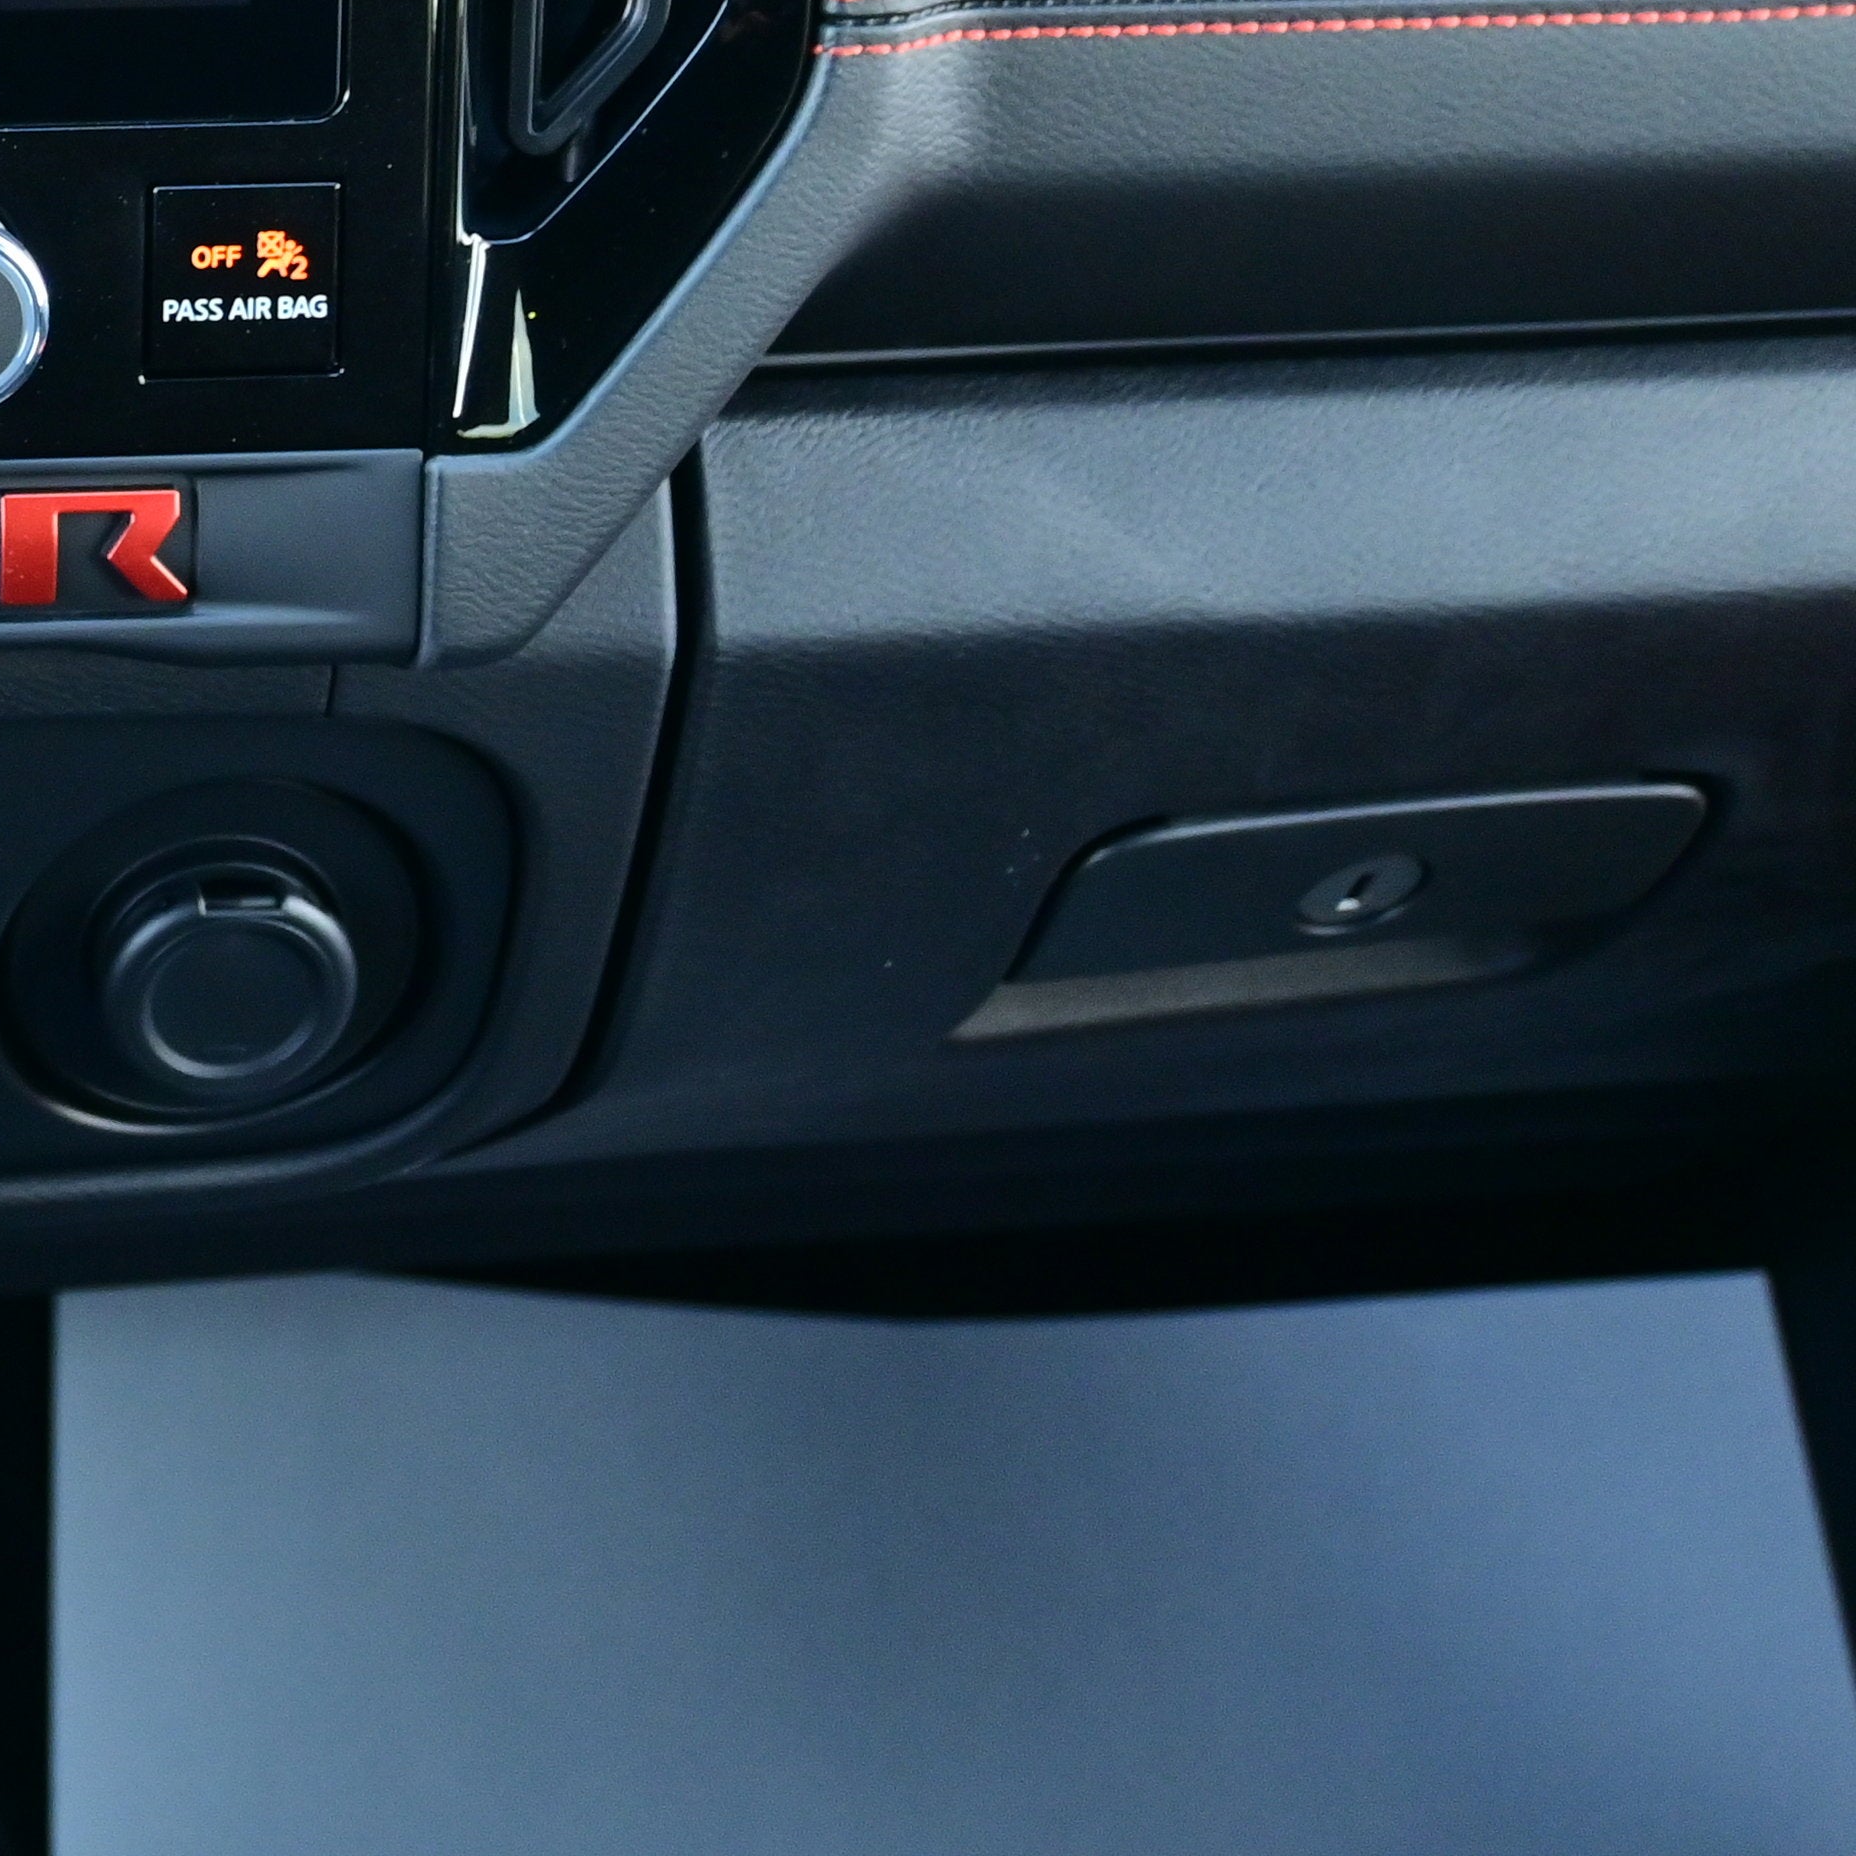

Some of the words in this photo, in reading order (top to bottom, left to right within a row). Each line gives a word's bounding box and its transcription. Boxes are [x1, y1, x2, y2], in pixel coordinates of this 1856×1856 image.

[191, 245, 242, 270] OFF
[162, 297, 224, 323] PASS
[228, 296, 272, 321] AIR
[276, 294, 329, 321] BAG
